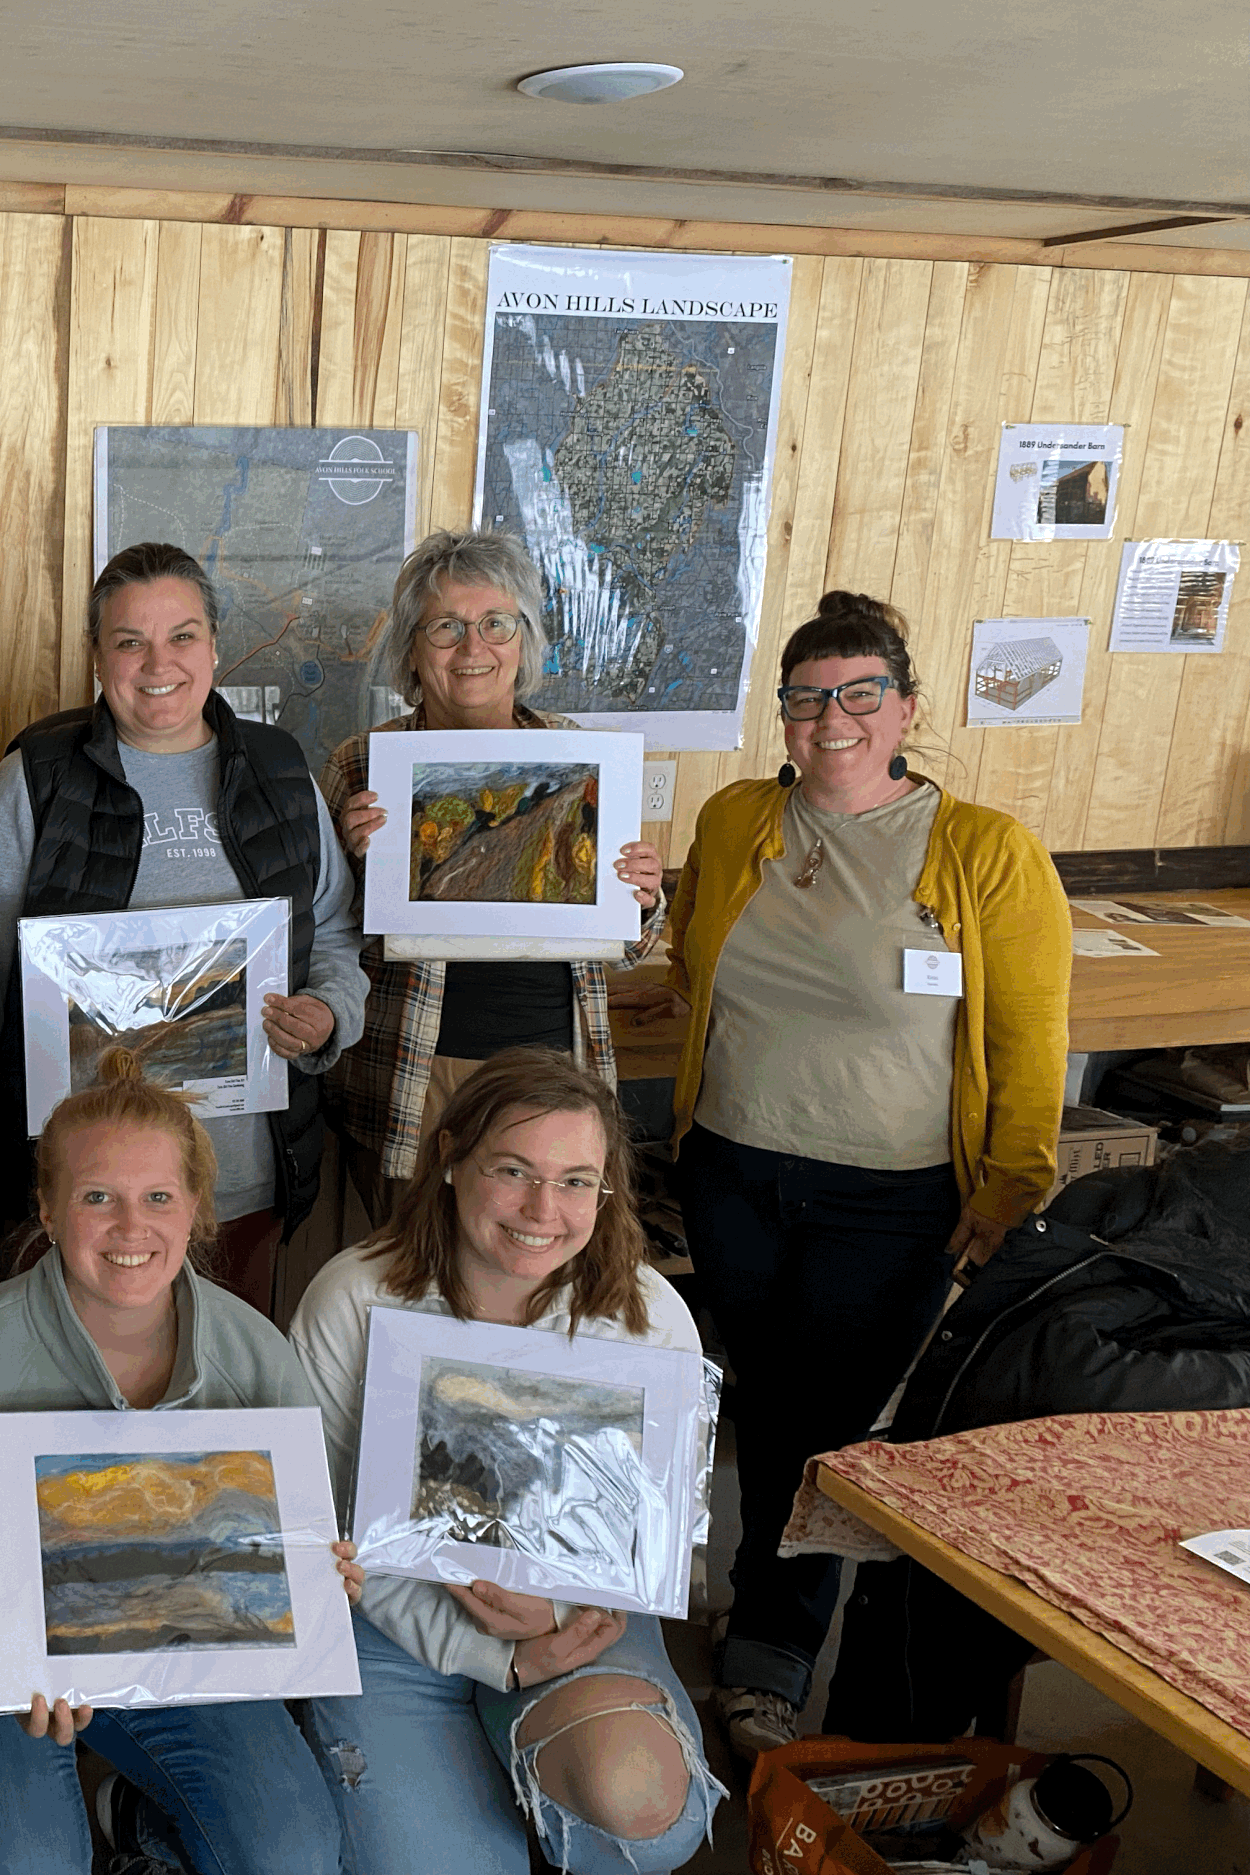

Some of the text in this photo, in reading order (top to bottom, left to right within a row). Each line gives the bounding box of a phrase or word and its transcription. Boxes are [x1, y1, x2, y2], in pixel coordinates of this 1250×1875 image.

[497, 291, 778, 319] AVON HILLS LANDSCAPE
[1019, 440, 1036, 449] 1889
[1087, 441, 1105, 450] Barn
[192, 848, 217, 858] 1998
